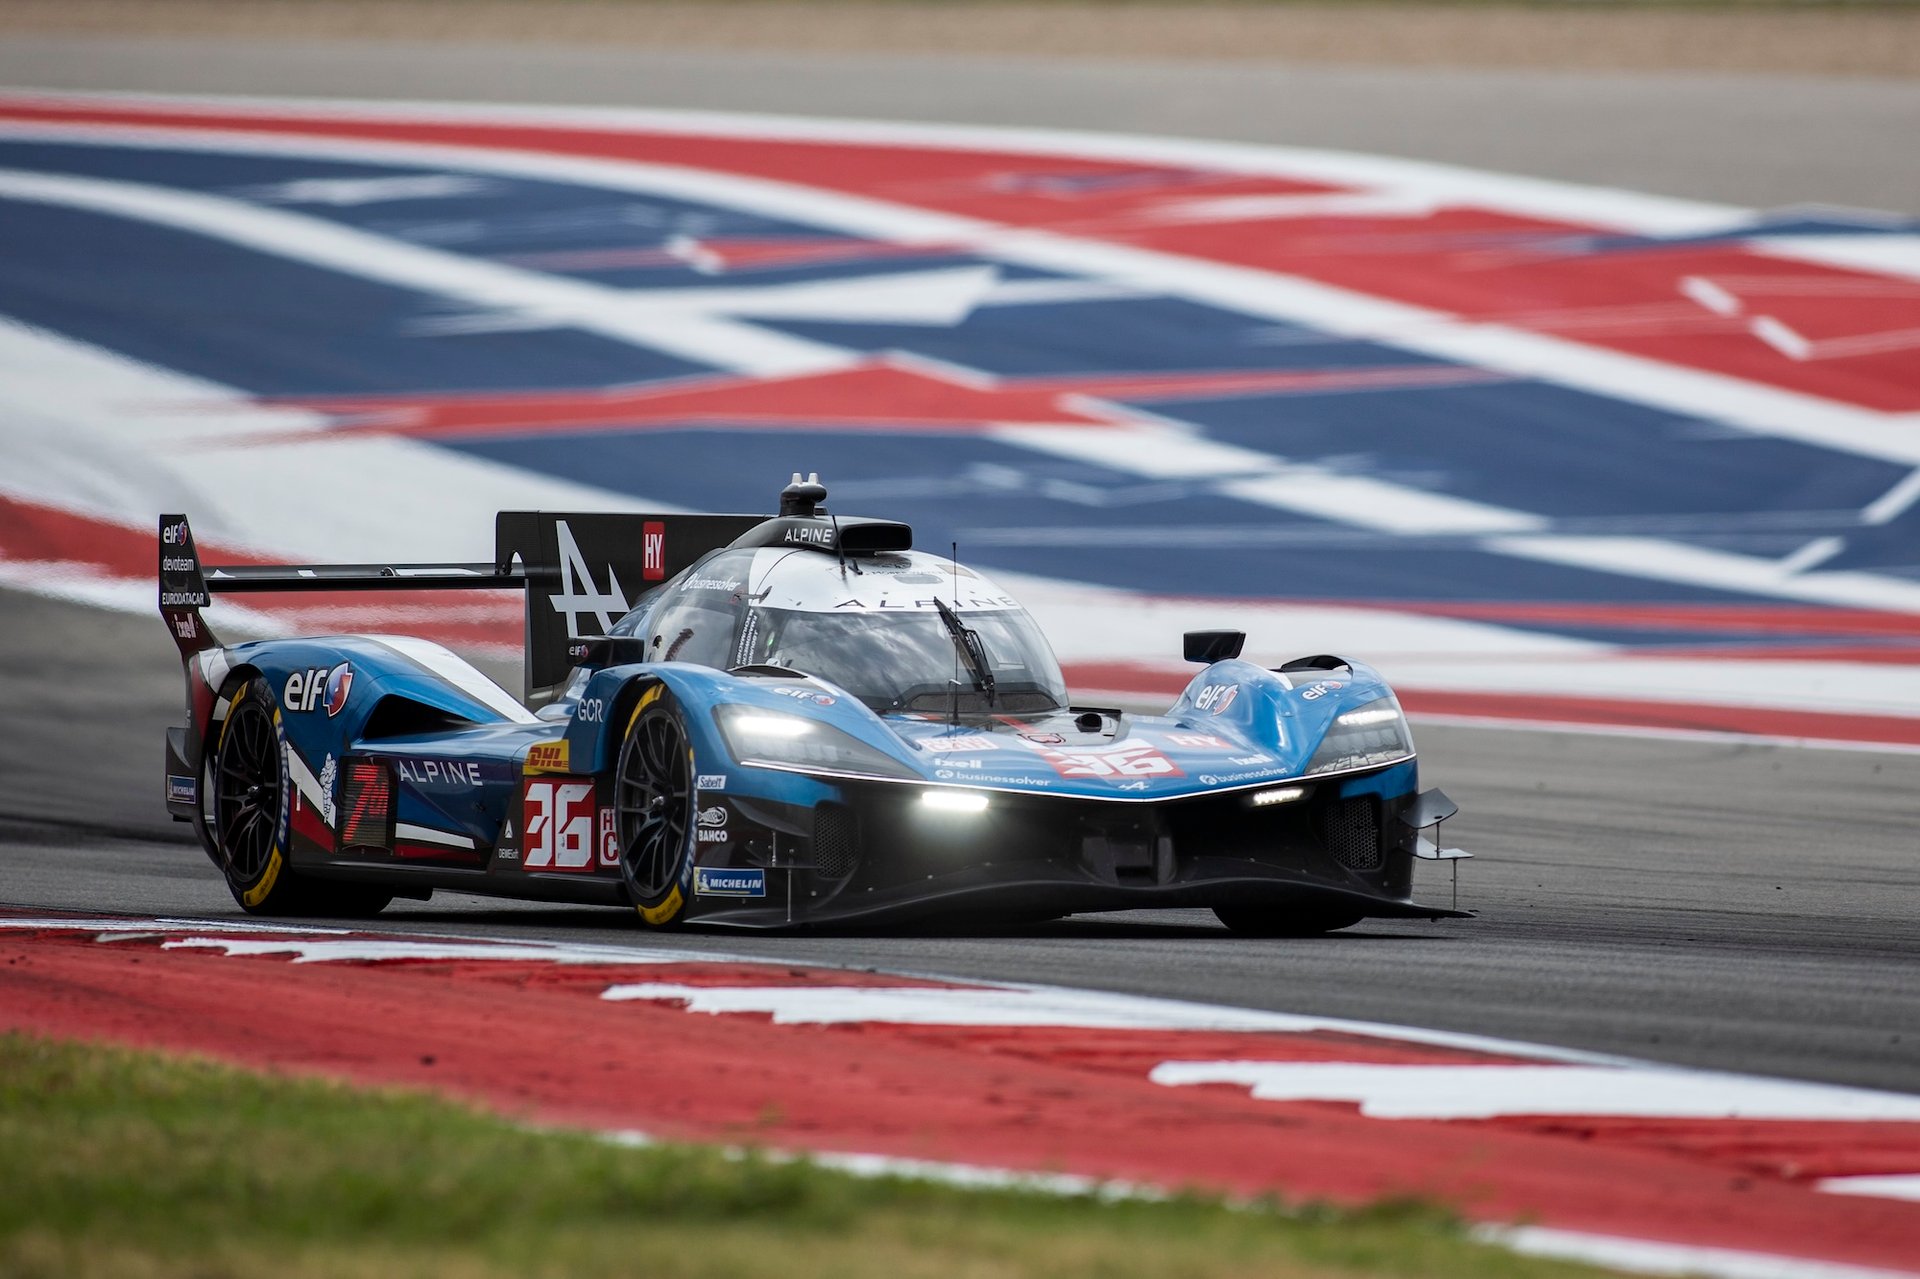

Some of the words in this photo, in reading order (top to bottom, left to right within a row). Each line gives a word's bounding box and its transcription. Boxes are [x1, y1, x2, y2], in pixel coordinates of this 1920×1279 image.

[784, 528, 833, 543] ALPINE
[645, 534, 662, 569] HY
[163, 557, 194, 571] devoteam
[162, 592, 205, 605] EURODATACAR
[577, 698, 603, 723] GCR
[528, 747, 562, 768] DHL
[1044, 748, 1175, 776] 36
[399, 760, 484, 787] ALPINE
[956, 770, 1051, 787] businessolver
[1213, 767, 1288, 783] businessolver
[700, 776, 722, 788] Sabelt
[524, 783, 595, 867] 36
[698, 830, 728, 842] BAHCO
[710, 875, 763, 889] MICHELIN
